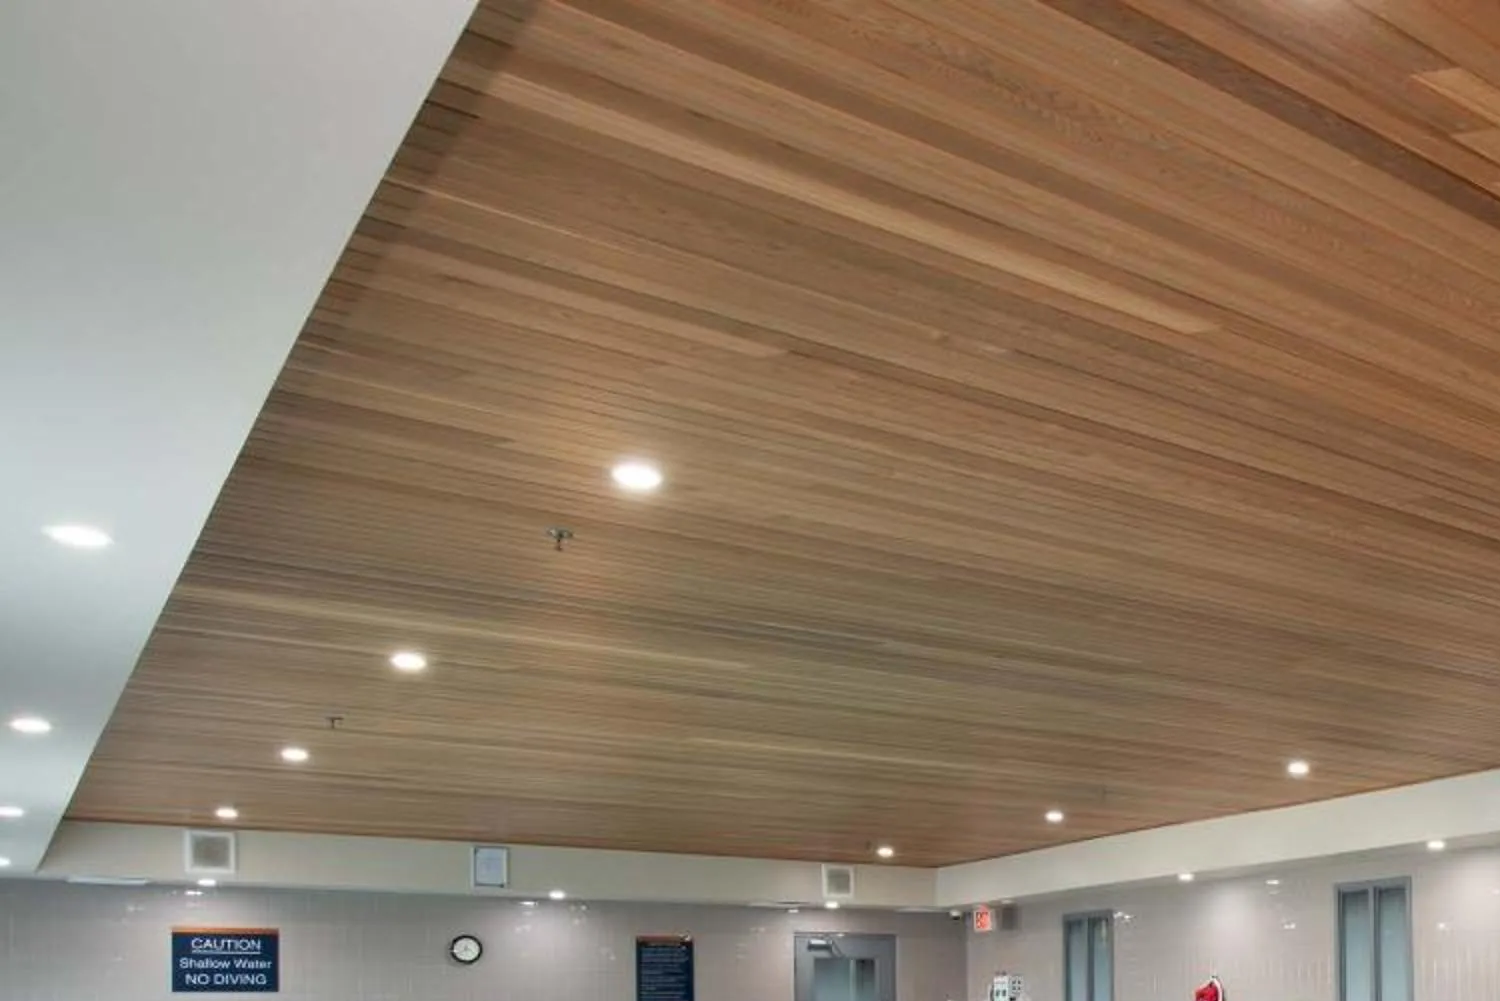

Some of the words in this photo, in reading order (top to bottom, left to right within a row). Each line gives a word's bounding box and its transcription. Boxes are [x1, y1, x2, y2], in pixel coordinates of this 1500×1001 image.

[191, 937, 261, 951] CAUTION
[179, 957, 231, 969] Shallow
[233, 958, 272, 969] Water
[185, 973, 211, 985] NO
[214, 973, 267, 985] DIVING
